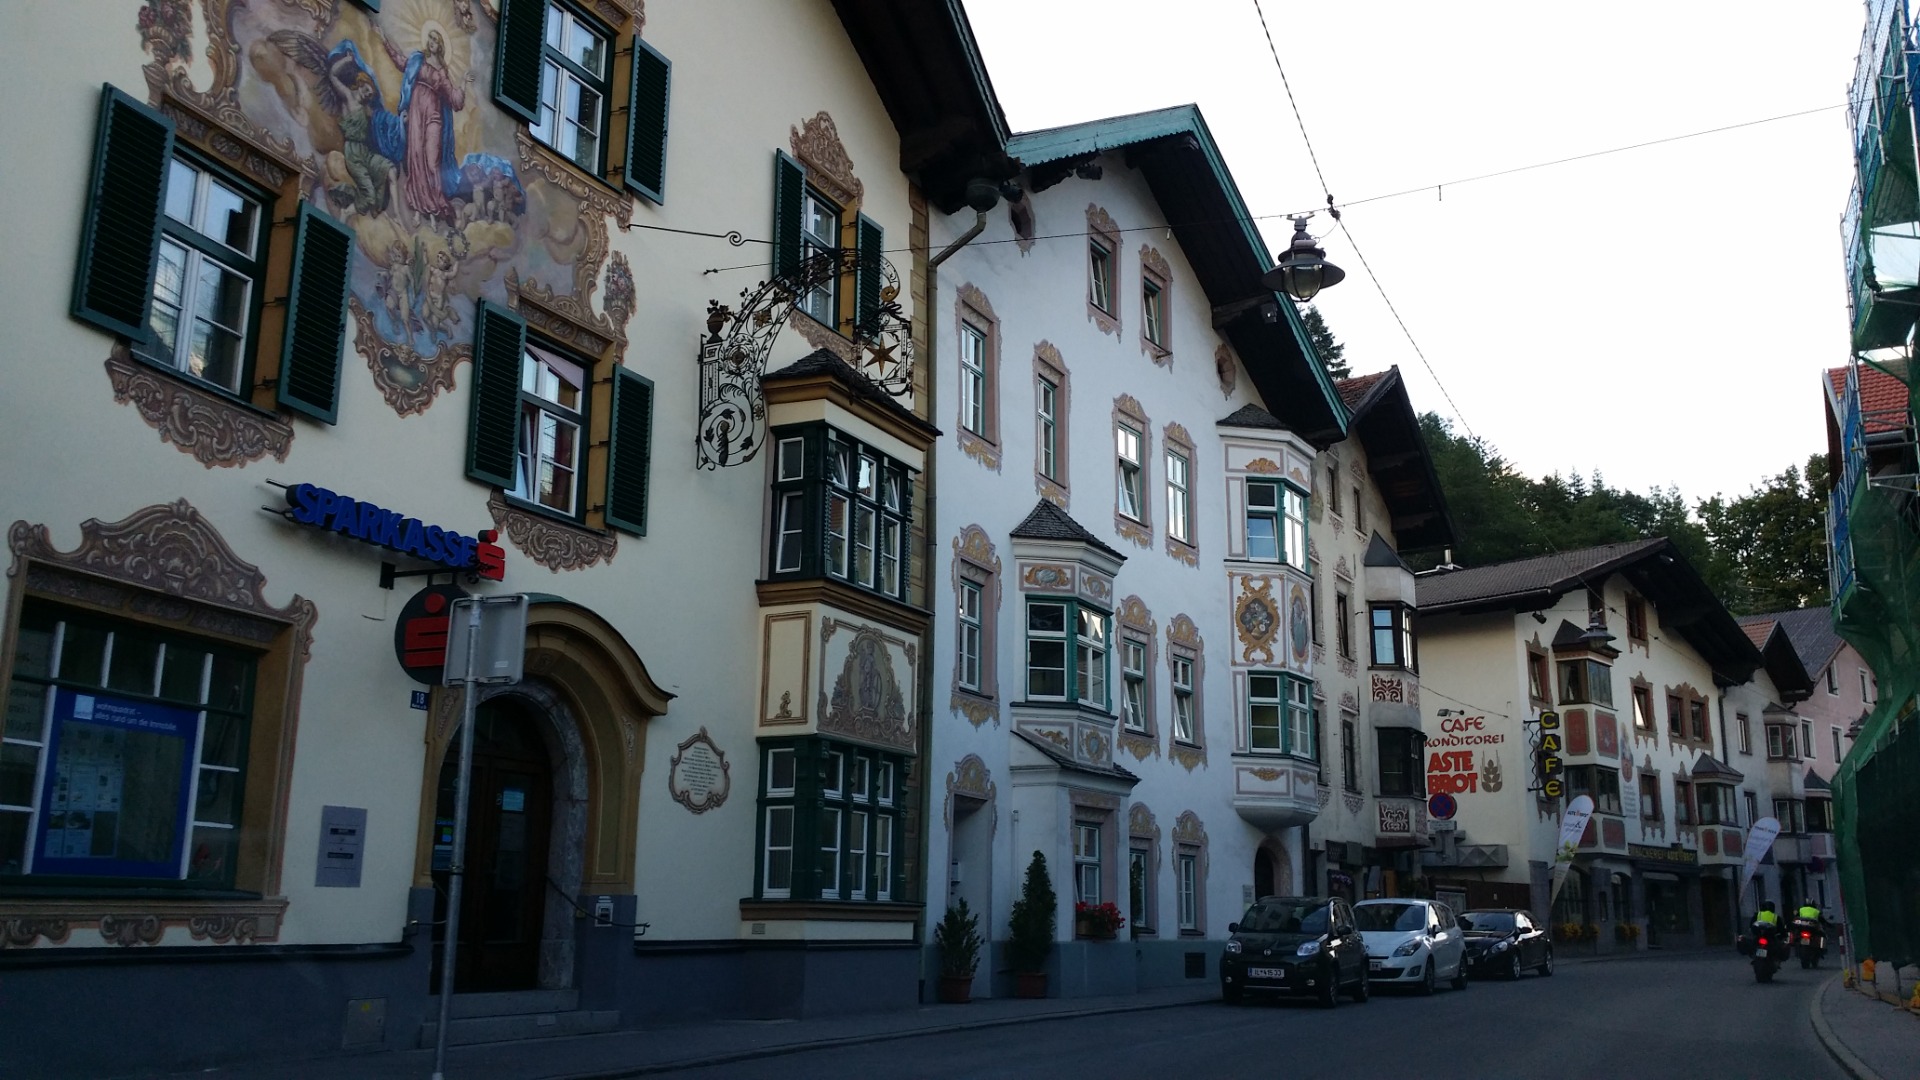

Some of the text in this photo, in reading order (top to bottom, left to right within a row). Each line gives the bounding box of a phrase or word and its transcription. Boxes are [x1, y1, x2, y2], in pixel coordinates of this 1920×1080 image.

[288, 483, 478, 568] SPARKASSE
[416, 692, 425, 704] 18
[1440, 716, 1486, 734] CAFE
[1424, 733, 1505, 748] KONDITOREI
[1427, 750, 1474, 773] ASTE
[1427, 772, 1478, 795] BROT
